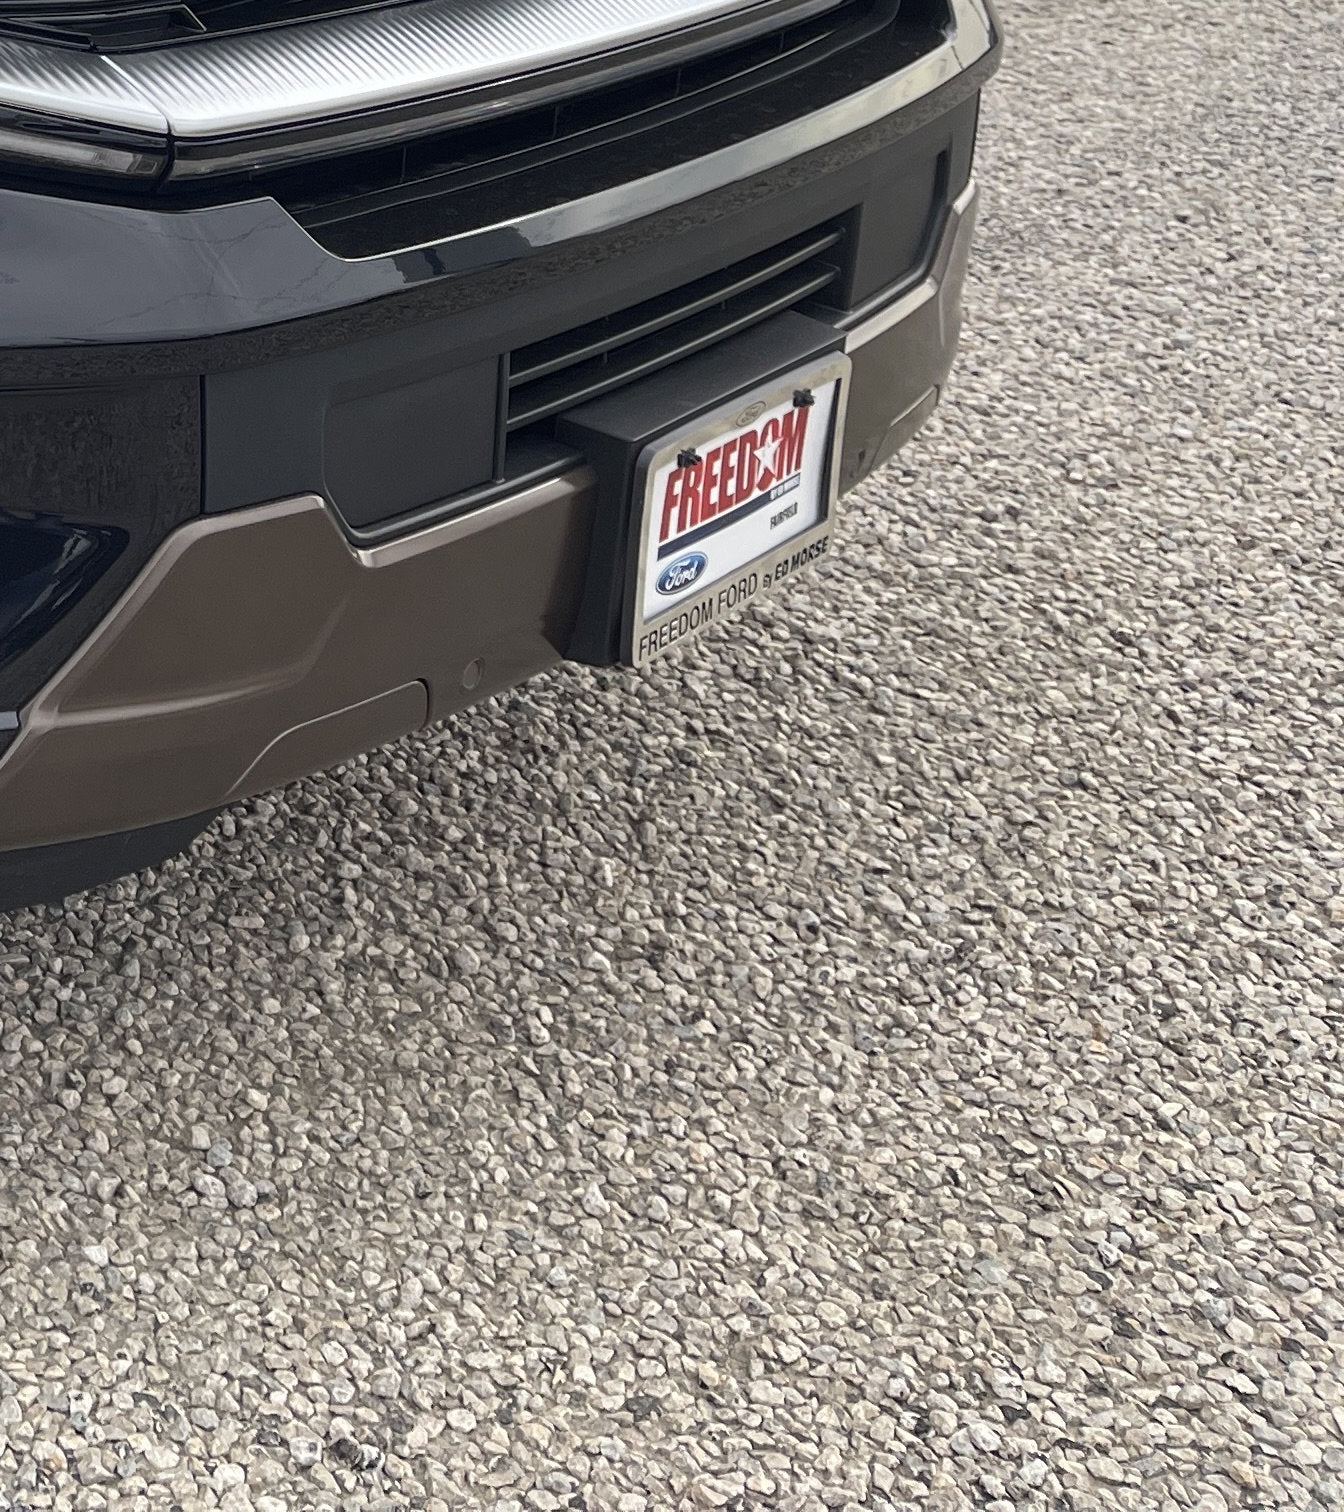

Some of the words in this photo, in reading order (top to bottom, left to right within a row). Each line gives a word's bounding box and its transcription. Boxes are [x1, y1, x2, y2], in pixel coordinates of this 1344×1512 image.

[659, 405, 810, 543] FREEDOM
[639, 597, 713, 662] FREEDOM
[717, 572, 758, 615] FORD
[775, 559, 788, 581] ED
[791, 536, 829, 572] MORSE
[665, 559, 698, 590] Ford
